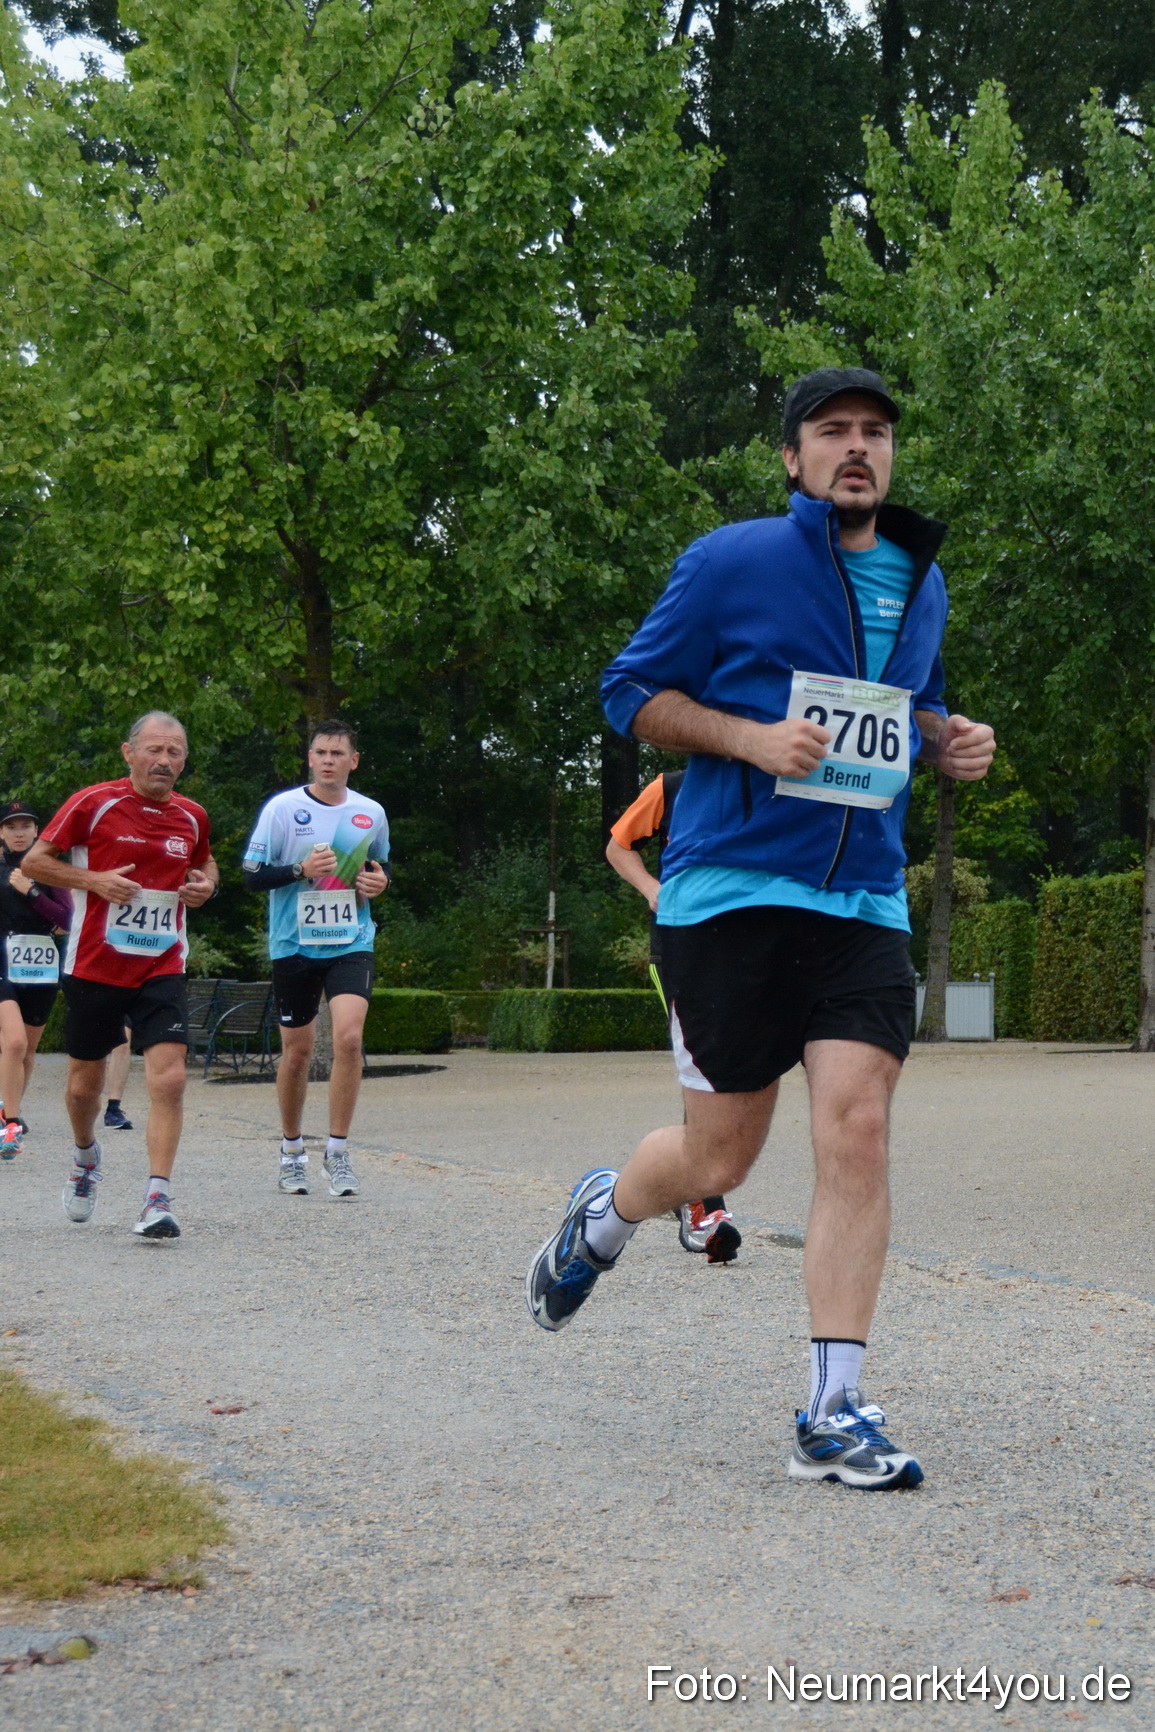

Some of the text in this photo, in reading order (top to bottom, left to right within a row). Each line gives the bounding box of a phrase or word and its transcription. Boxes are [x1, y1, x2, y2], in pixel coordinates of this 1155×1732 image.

[803, 687, 845, 699] NeuerMarkt
[852, 685, 902, 707] BOCK
[823, 765, 871, 790] Bernd
[115, 904, 172, 932] 2414
[304, 903, 353, 924] 2114
[126, 934, 160, 948] Rudolf
[311, 928, 348, 938] Christoph
[12, 946, 55, 965] 2429
[20, 968, 44, 977] Sandra
